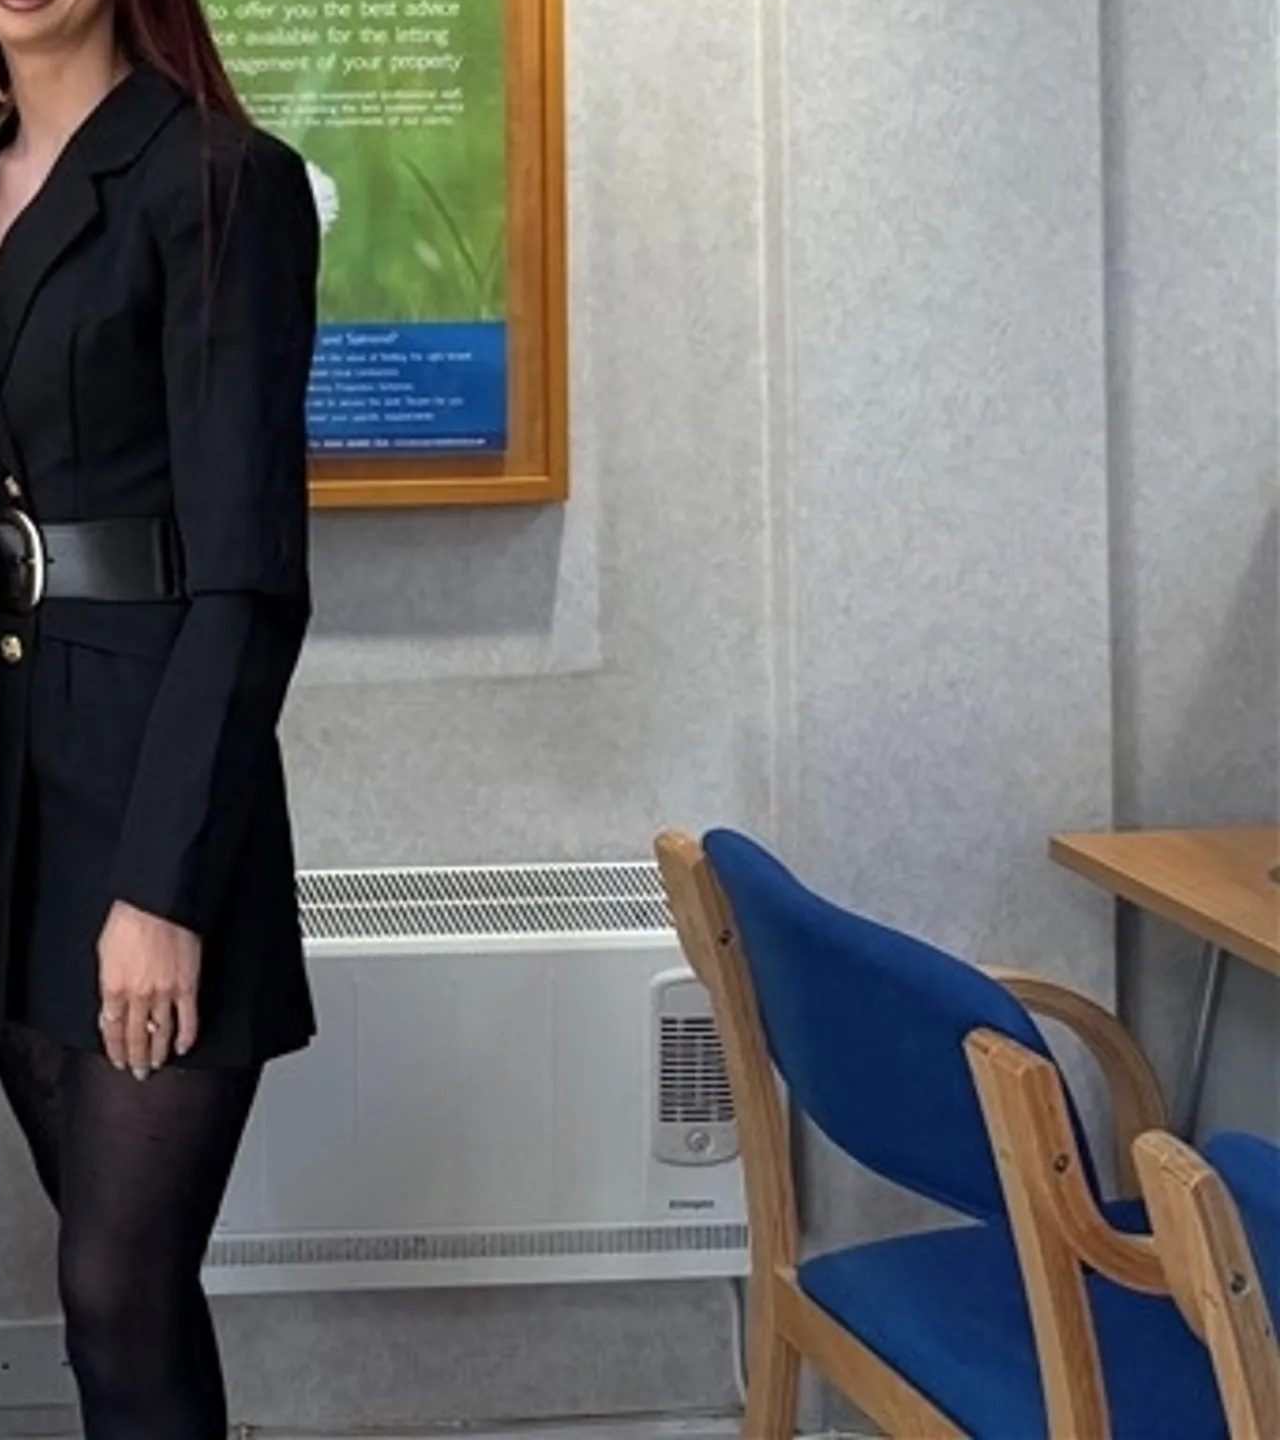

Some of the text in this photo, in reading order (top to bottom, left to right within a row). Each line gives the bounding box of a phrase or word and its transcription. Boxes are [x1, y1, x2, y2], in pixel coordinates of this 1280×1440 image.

[235, 0, 275, 20] offer
[283, 3, 318, 23] you
[324, 0, 352, 18] the
[359, 0, 397, 18] best
[403, 0, 460, 18] advice
[244, 27, 320, 47] available
[326, 26, 351, 45] for
[358, 26, 388, 45] the
[394, 26, 450, 48] letting
[316, 52, 337, 71] of
[342, 56, 382, 77] your
[390, 54, 464, 74] property
